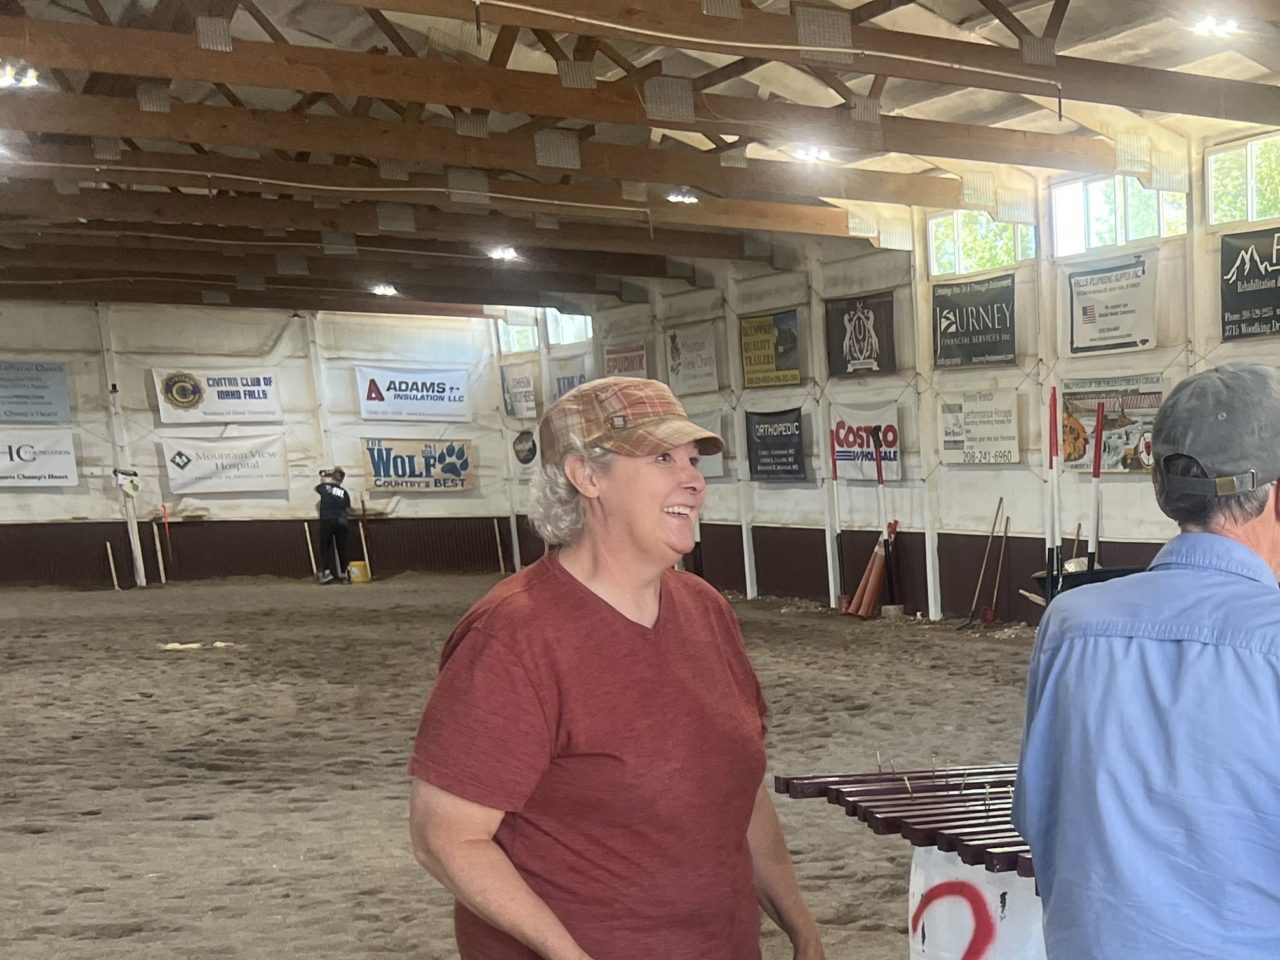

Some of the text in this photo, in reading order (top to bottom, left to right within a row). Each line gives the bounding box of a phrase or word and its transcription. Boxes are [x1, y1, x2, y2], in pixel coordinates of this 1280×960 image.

[1237, 278, 1276, 293] Rehabilitation
[941, 334, 1000, 346] FINANCIAL SERVICES
[386, 380, 446, 394] ADAMS
[393, 393, 465, 403] INSULATION LLC
[755, 422, 800, 437] ORTHOPEDIC
[195, 450, 278, 462] Mountain View
[851, 450, 898, 462] WHOLSALE
[963, 450, 1013, 463] 208-241-6960
[215, 461, 260, 472] Hospital
[434, 478, 467, 488] BEST
